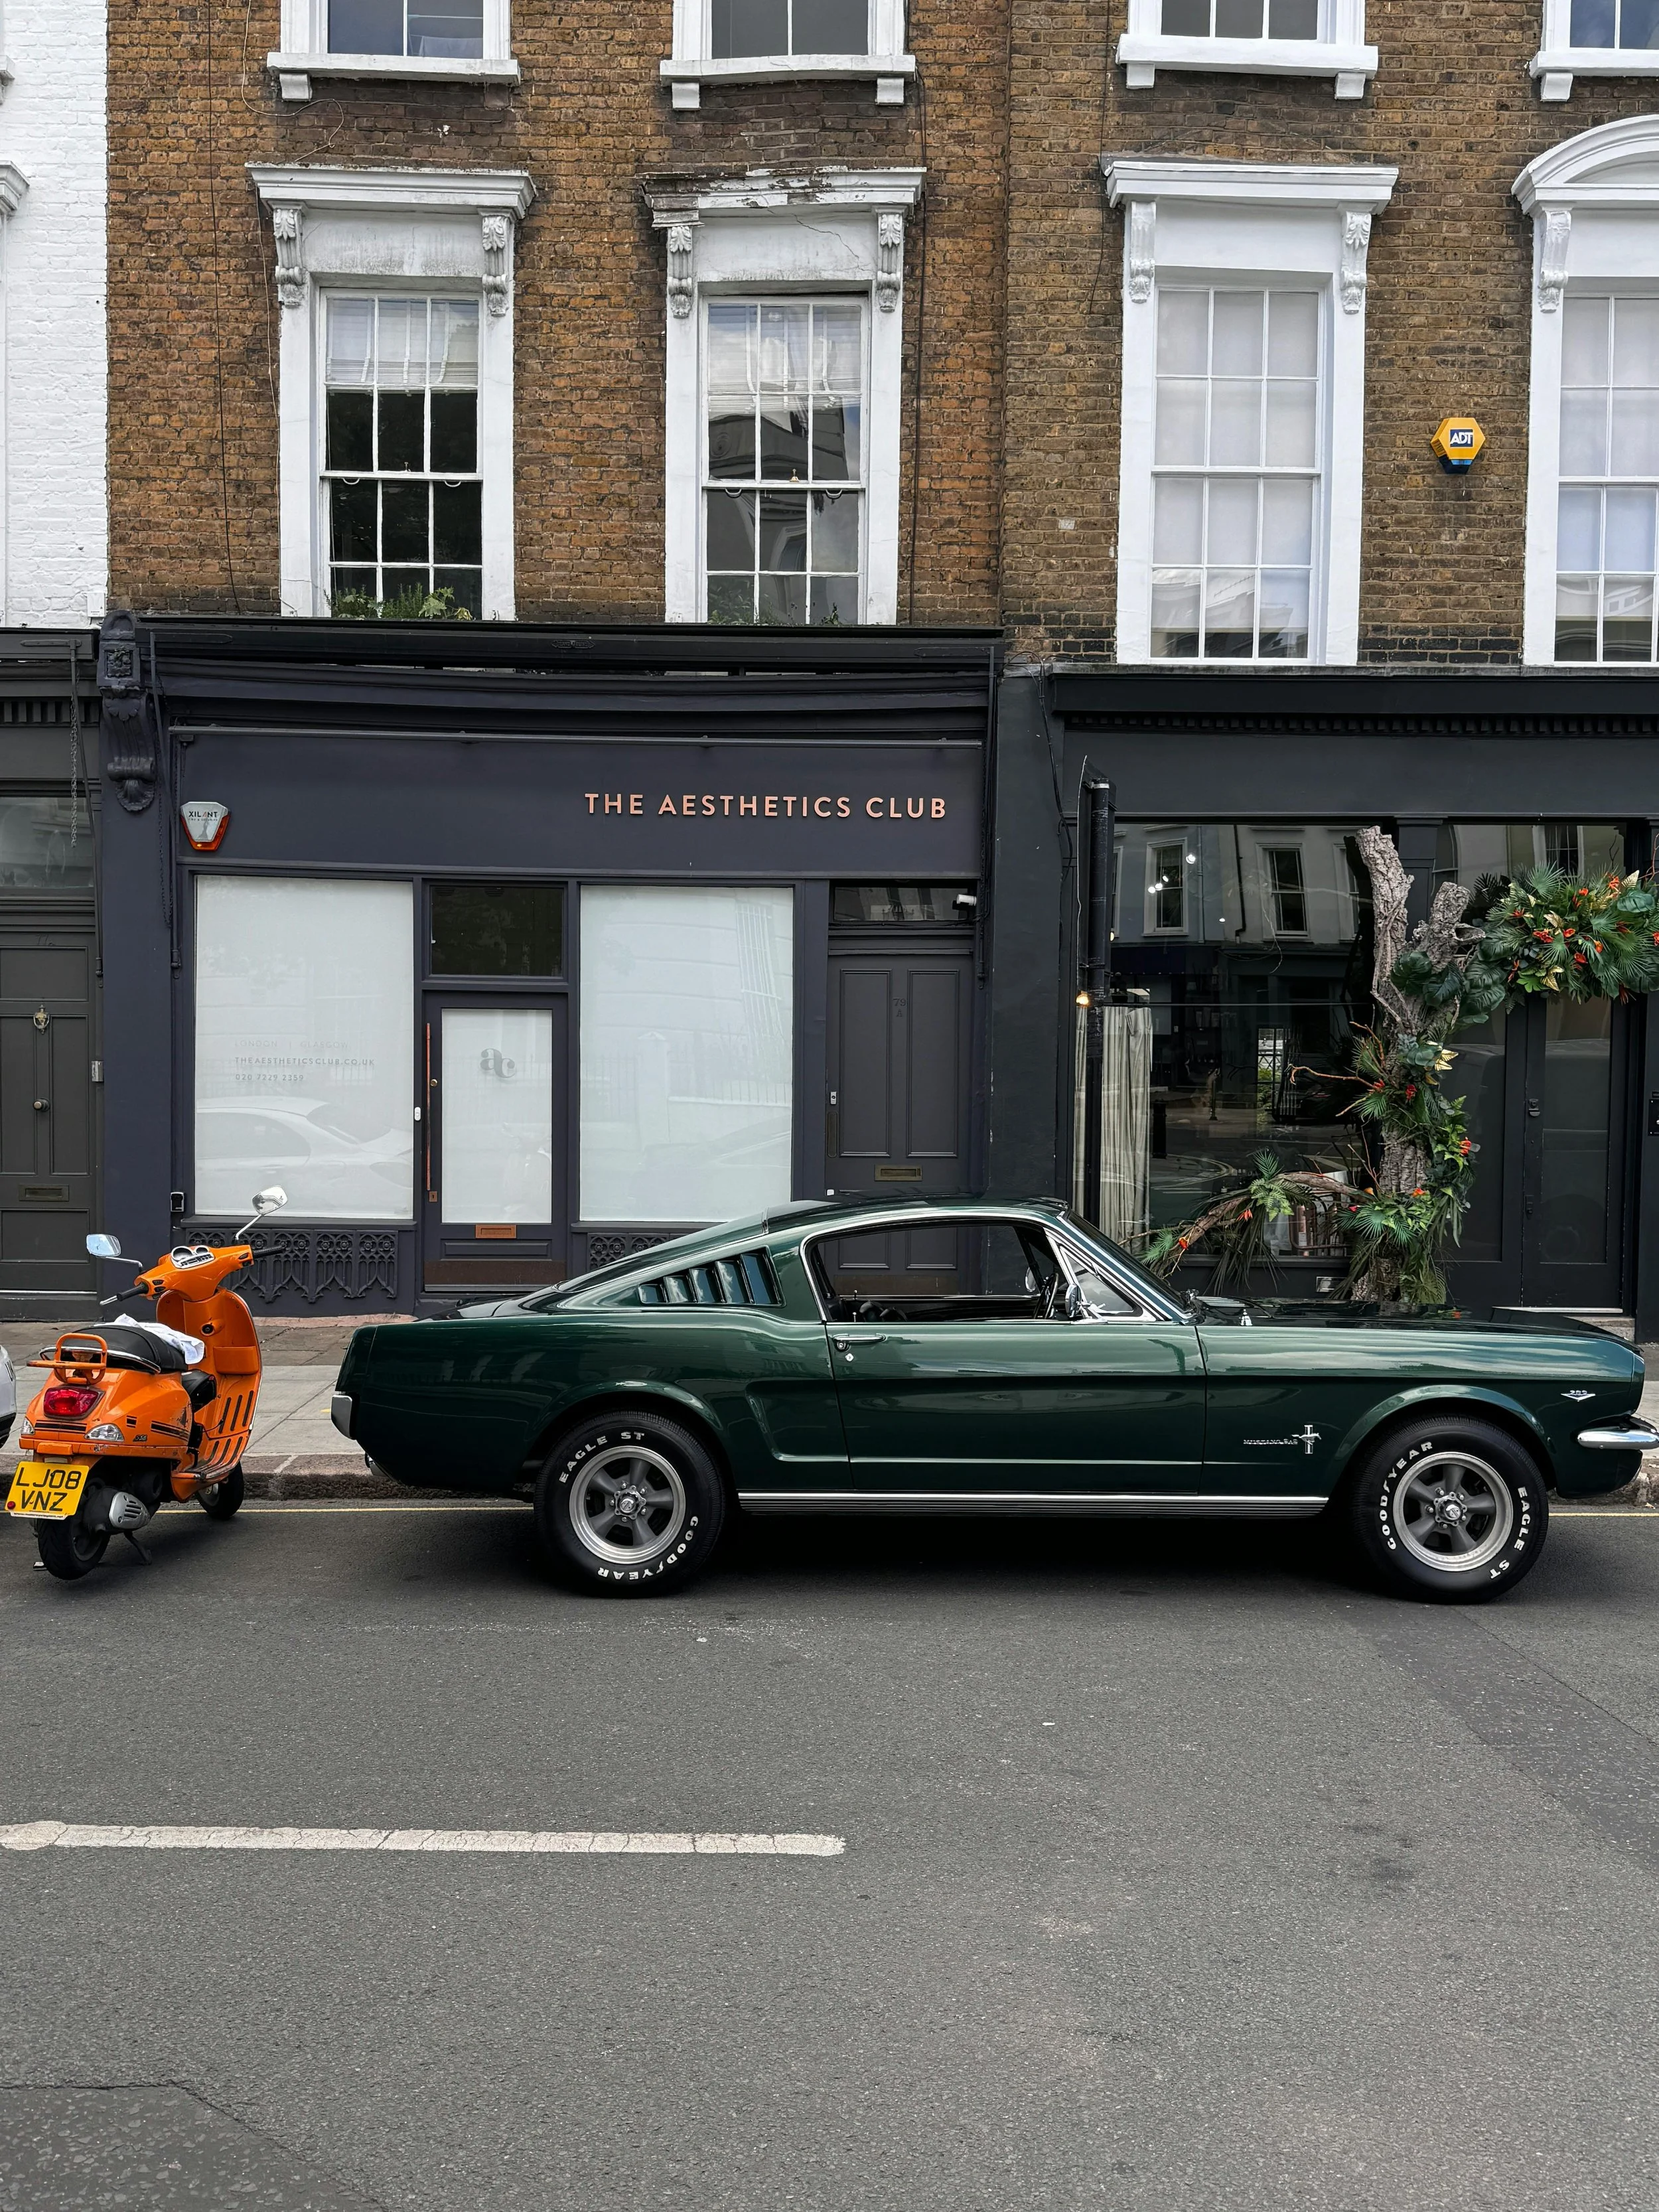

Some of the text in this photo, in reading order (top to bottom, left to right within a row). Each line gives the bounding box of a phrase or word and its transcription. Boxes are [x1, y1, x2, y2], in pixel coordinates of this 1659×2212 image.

[1450, 431, 1473, 444] ADT
[585, 793, 946, 818] THE AESTHETICS CLUB
[235, 1057, 375, 1066] THEAESTHETICSCLUB.CO.UK
[559, 1432, 645, 1483] EAGLE ST
[16, 1467, 82, 1490] LJ08
[21, 1489, 68, 1512] VNZ
[1380, 1441, 1433, 1550] GOODYEAR
[1490, 1487, 1531, 1579] EAGLE ST
[598, 1516, 698, 1580] GOODYEAR
